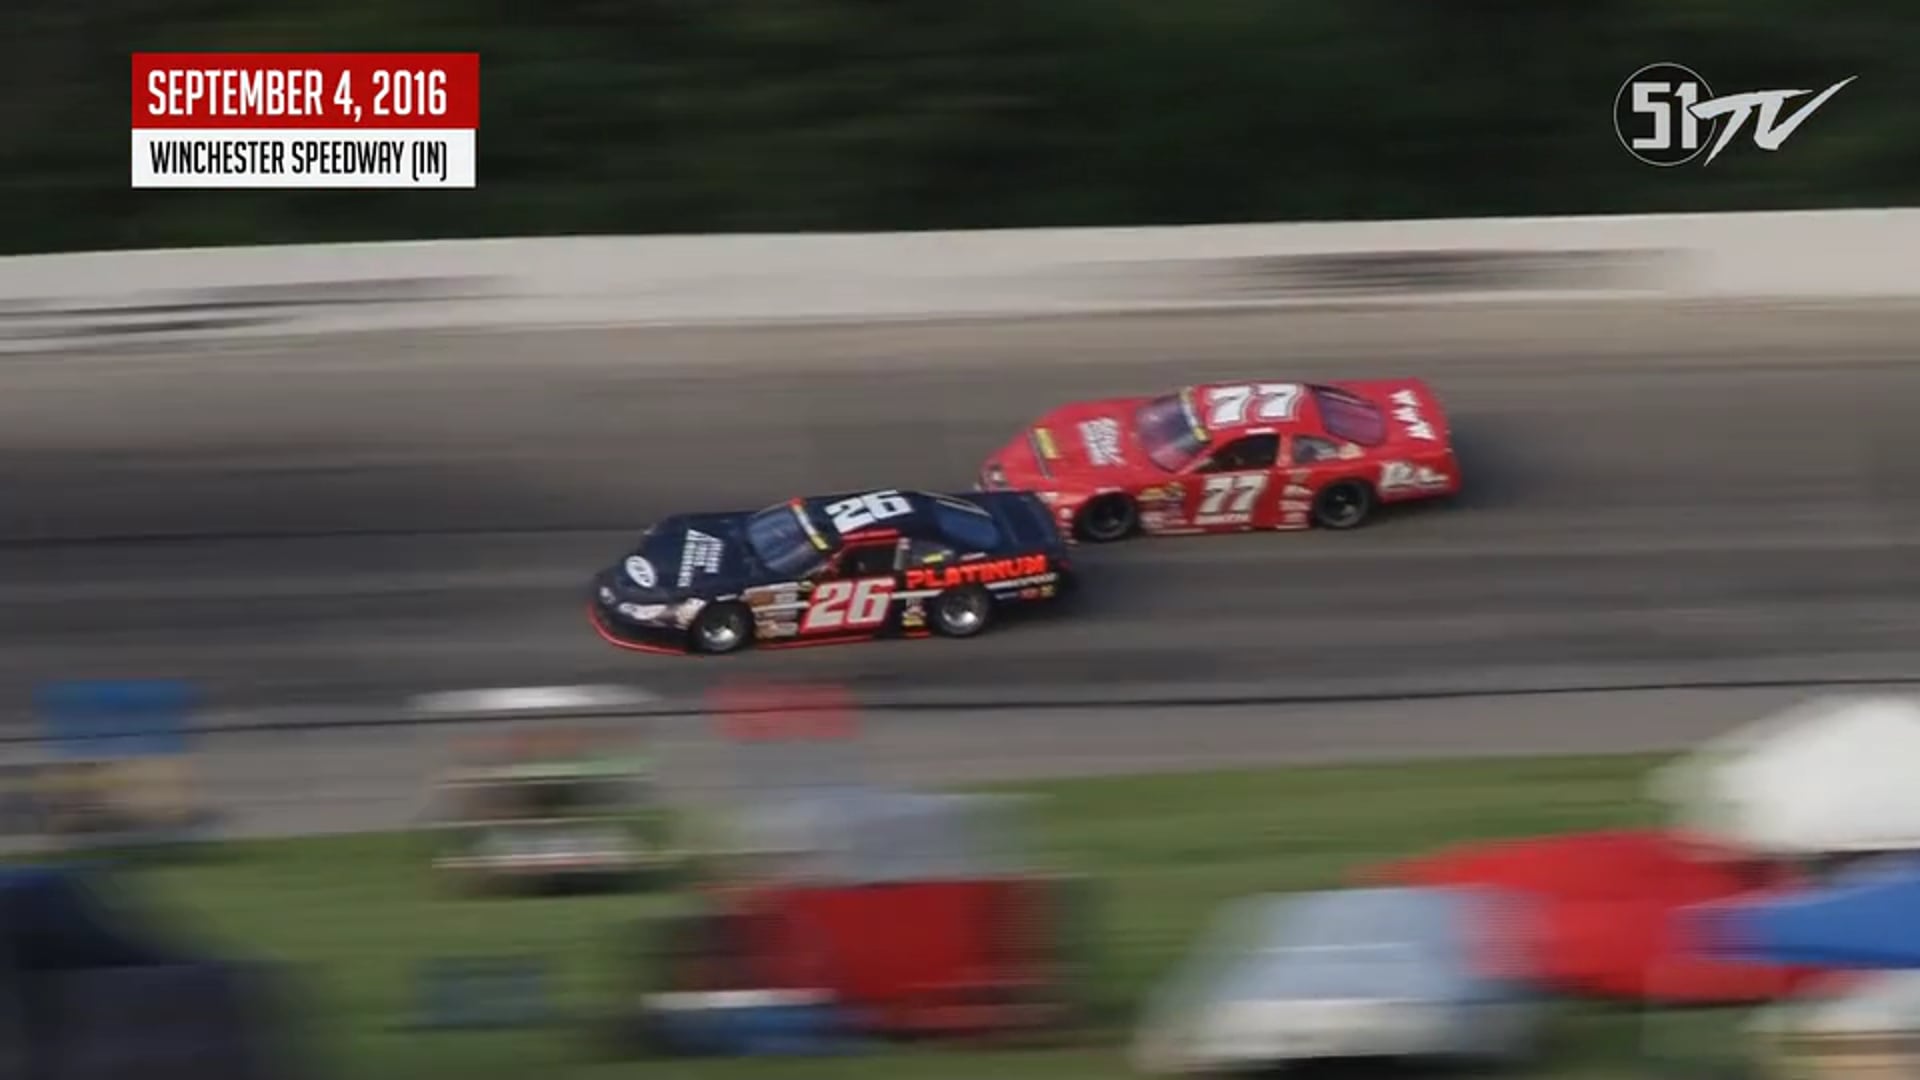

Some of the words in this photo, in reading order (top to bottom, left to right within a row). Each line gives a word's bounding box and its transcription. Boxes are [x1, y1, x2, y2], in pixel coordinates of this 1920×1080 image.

[1207, 383, 1299, 427] 77
[823, 489, 914, 534] 26
[1197, 475, 1267, 513] 77
[906, 554, 1047, 589] PLATINUM
[803, 577, 895, 631] 26
